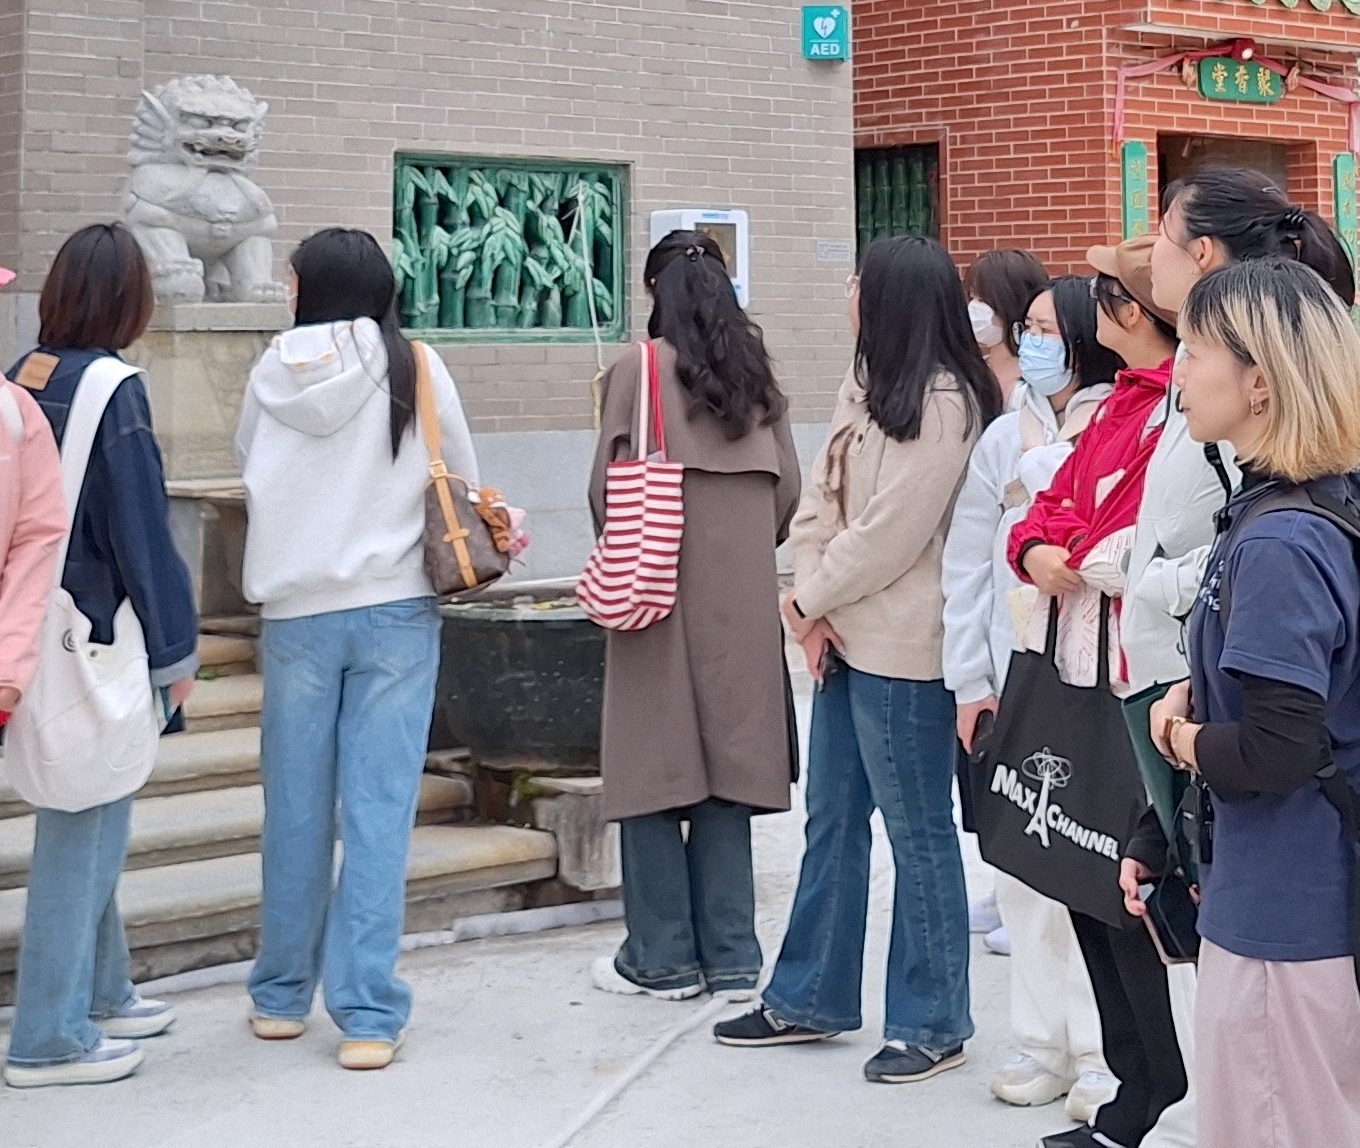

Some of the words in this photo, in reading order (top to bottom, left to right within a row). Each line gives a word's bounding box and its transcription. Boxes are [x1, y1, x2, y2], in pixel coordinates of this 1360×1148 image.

[810, 43, 840, 56] AED
[990, 763, 1038, 815] MAX
[1046, 804, 1120, 862] CHANNEL
